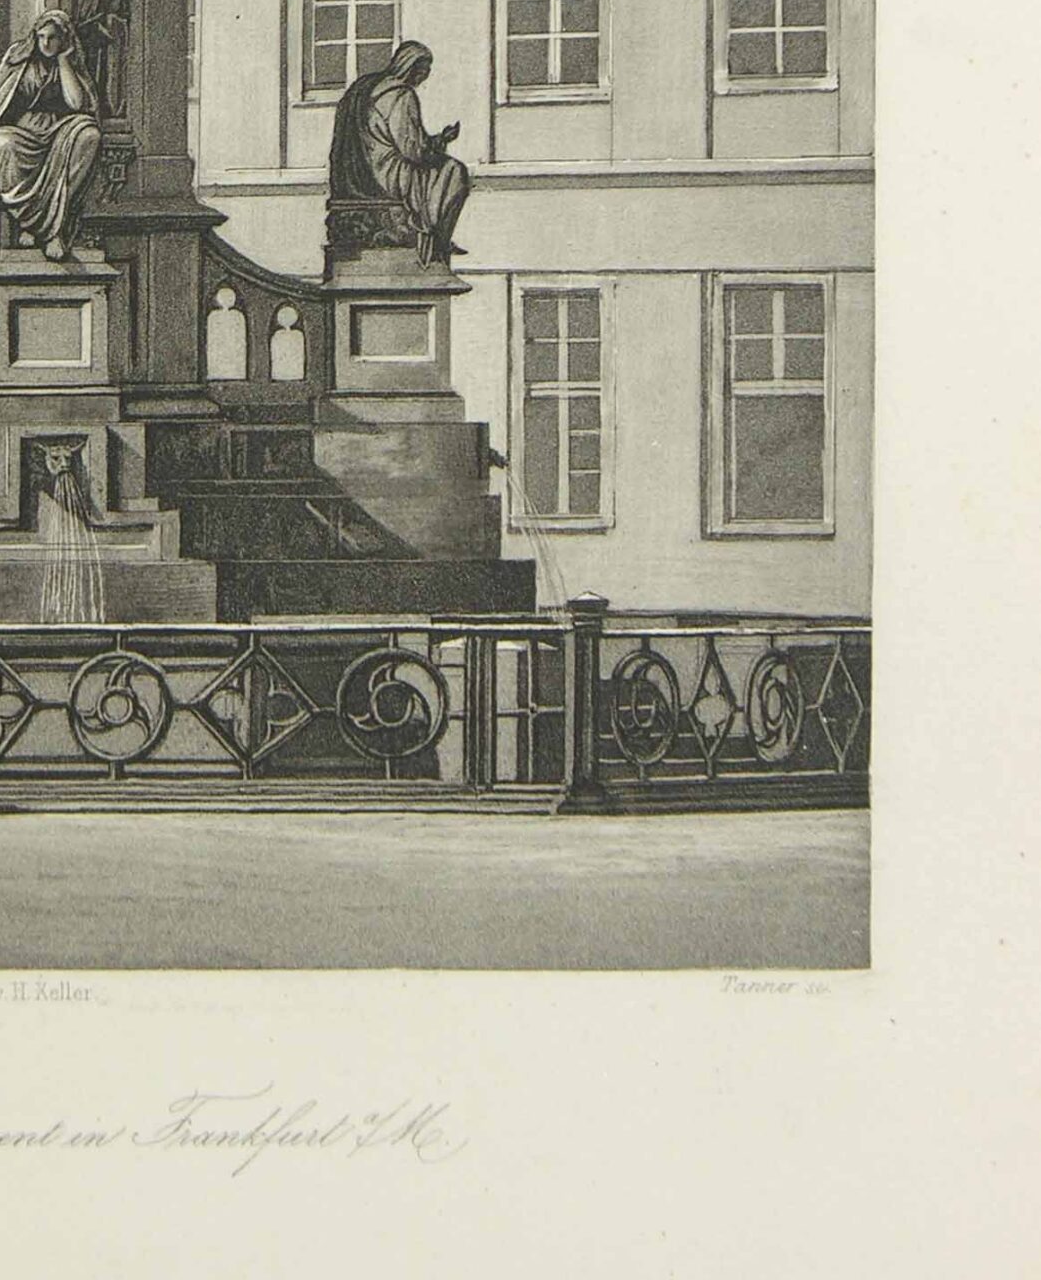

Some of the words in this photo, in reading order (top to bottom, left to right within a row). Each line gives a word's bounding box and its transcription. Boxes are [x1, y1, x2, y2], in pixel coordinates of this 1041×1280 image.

[35, 980, 91, 1002] Keller
[720, 975, 799, 994] Tanner
[68, 1114, 125, 1149] in
[132, 1080, 354, 1178] Frankfurt
